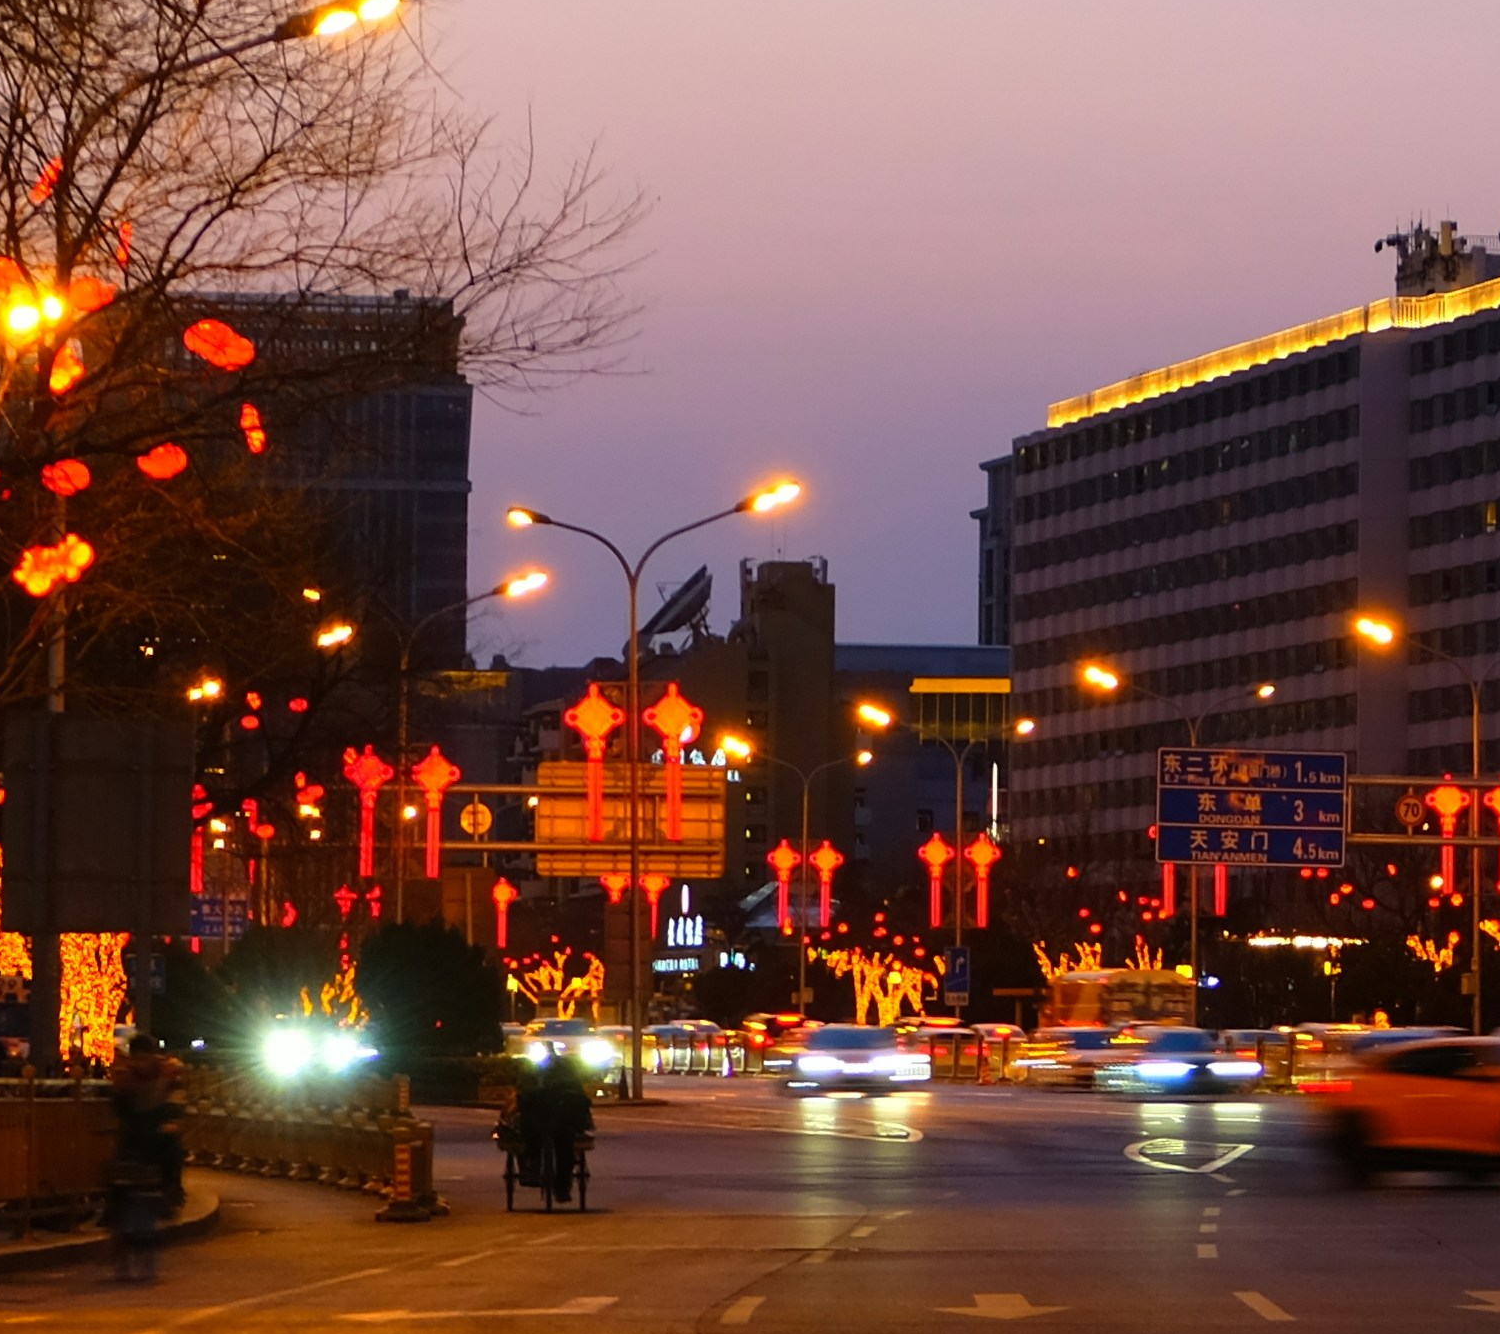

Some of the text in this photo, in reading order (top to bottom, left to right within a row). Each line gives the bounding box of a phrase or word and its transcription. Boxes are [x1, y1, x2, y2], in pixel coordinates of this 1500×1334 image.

[1163, 753, 1228, 773] 东二环
[1294, 761, 1341, 784] 1.5 km
[1197, 793, 1263, 812] 东单
[1294, 799, 1340, 824] 3 km
[1403, 802, 1420, 818] 70
[1199, 814, 1261, 825] DONGDAN
[1190, 829, 1269, 850] 天安门
[1292, 836, 1340, 861] 4.5 km
